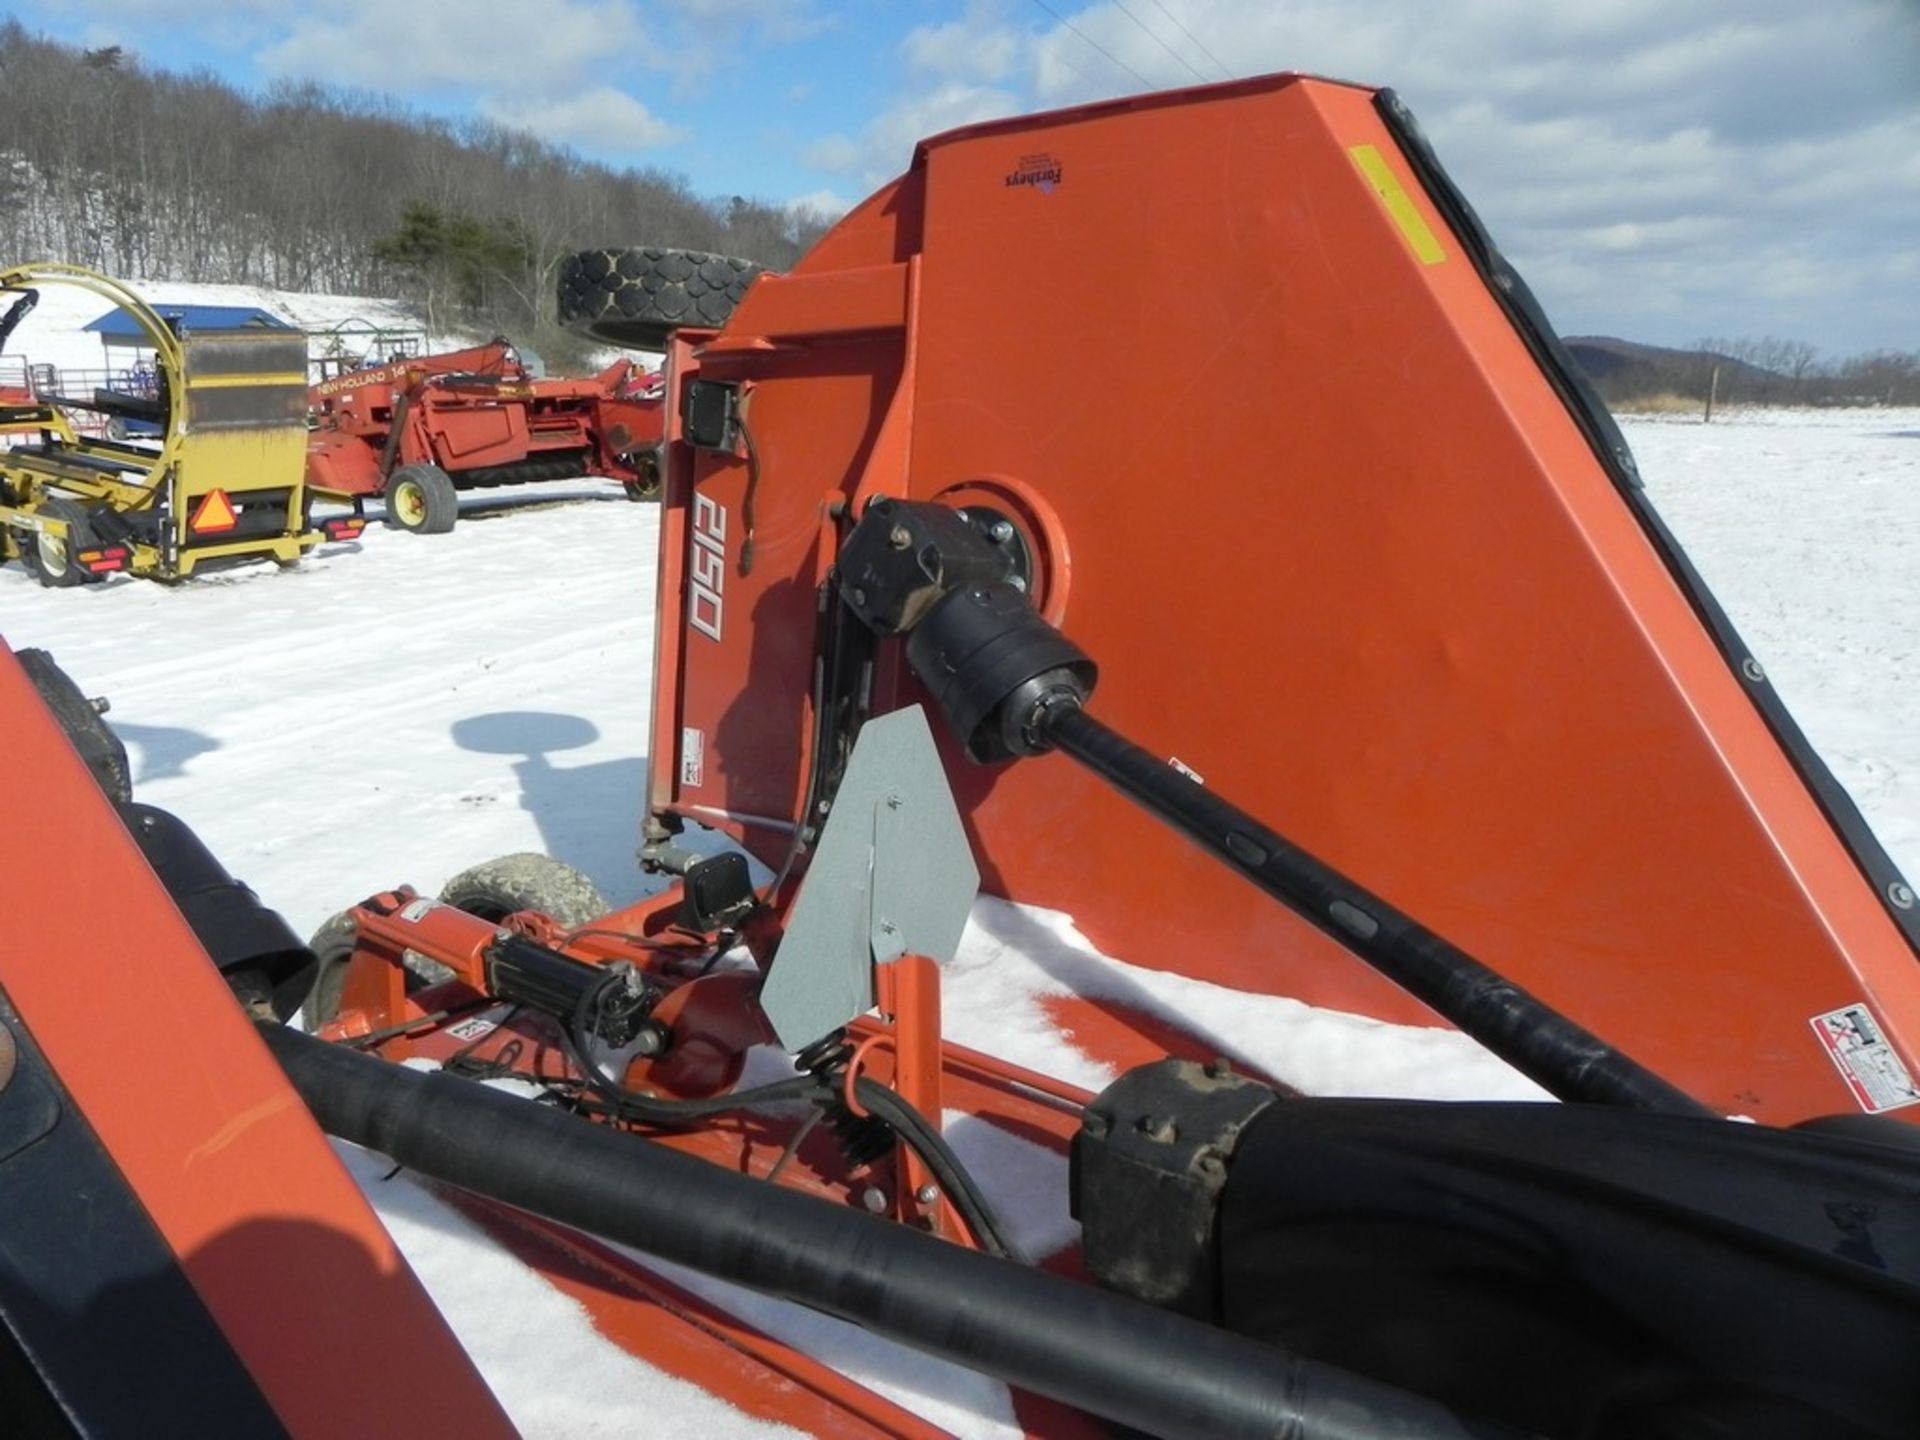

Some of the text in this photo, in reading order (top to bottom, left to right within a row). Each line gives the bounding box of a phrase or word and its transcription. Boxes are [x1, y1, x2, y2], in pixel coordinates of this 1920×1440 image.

[1005, 168, 1062, 186] Forsheys
[316, 382, 339, 395] NEW
[340, 372, 385, 390] HOLLAND
[690, 490, 727, 642] 2150
